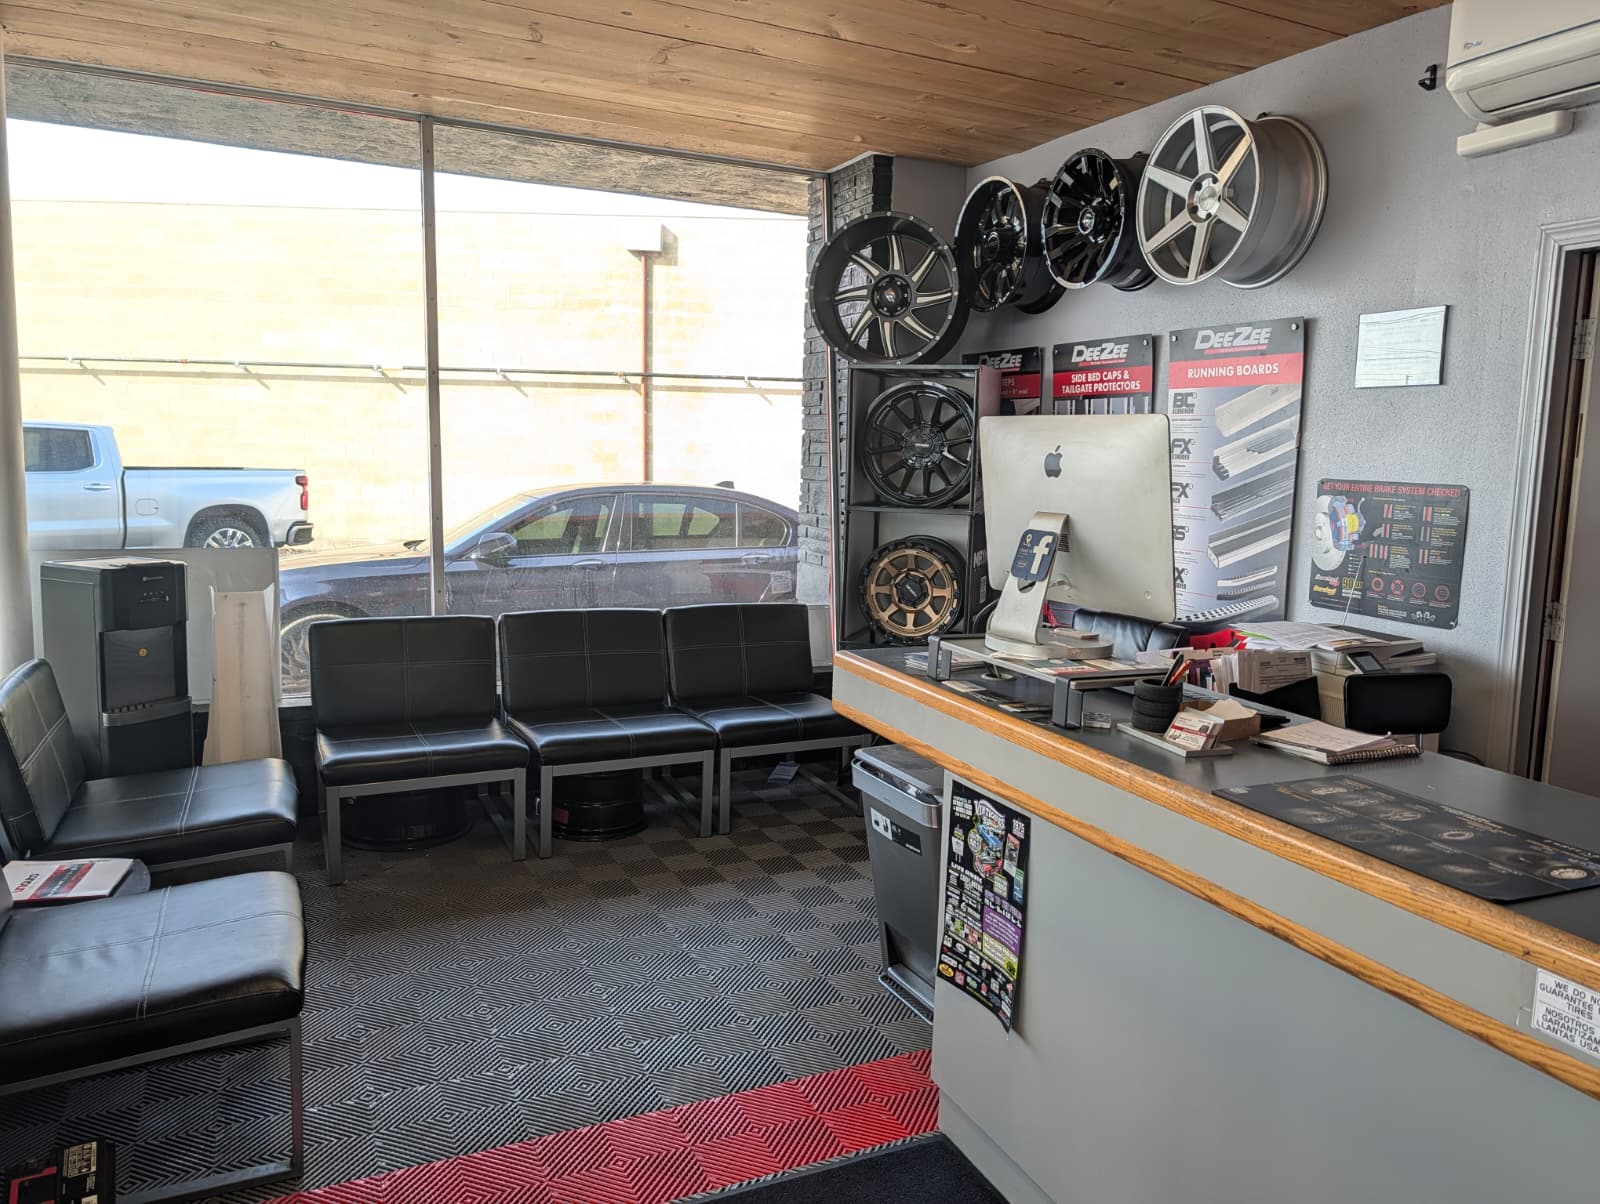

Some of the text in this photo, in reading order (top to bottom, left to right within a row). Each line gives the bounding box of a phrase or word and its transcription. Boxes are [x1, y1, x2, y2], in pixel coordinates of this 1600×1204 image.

[1071, 369, 1130, 383] SIDE BED CAPS &
[1187, 363, 1279, 379] RUNNING BOARDS
[1062, 380, 1141, 394] TAILGATE PROTECTORS
[1173, 392, 1196, 409] BC
[1335, 482, 1350, 491] YOUR
[1350, 483, 1373, 493] ENTIRE
[1374, 484, 1396, 494] BRAKE
[1397, 486, 1425, 496] SYSTEM
[1426, 488, 1461, 497] CHECKED
[1539, 983, 1594, 1012] GUARANTEE
[1554, 980, 1569, 992] WE
[1572, 988, 1586, 999] DO
[1567, 1002, 1593, 1020] TIRES
[1545, 1007, 1595, 1035] NOSOTROS
[1536, 1019, 1576, 1043] LLANTAS
